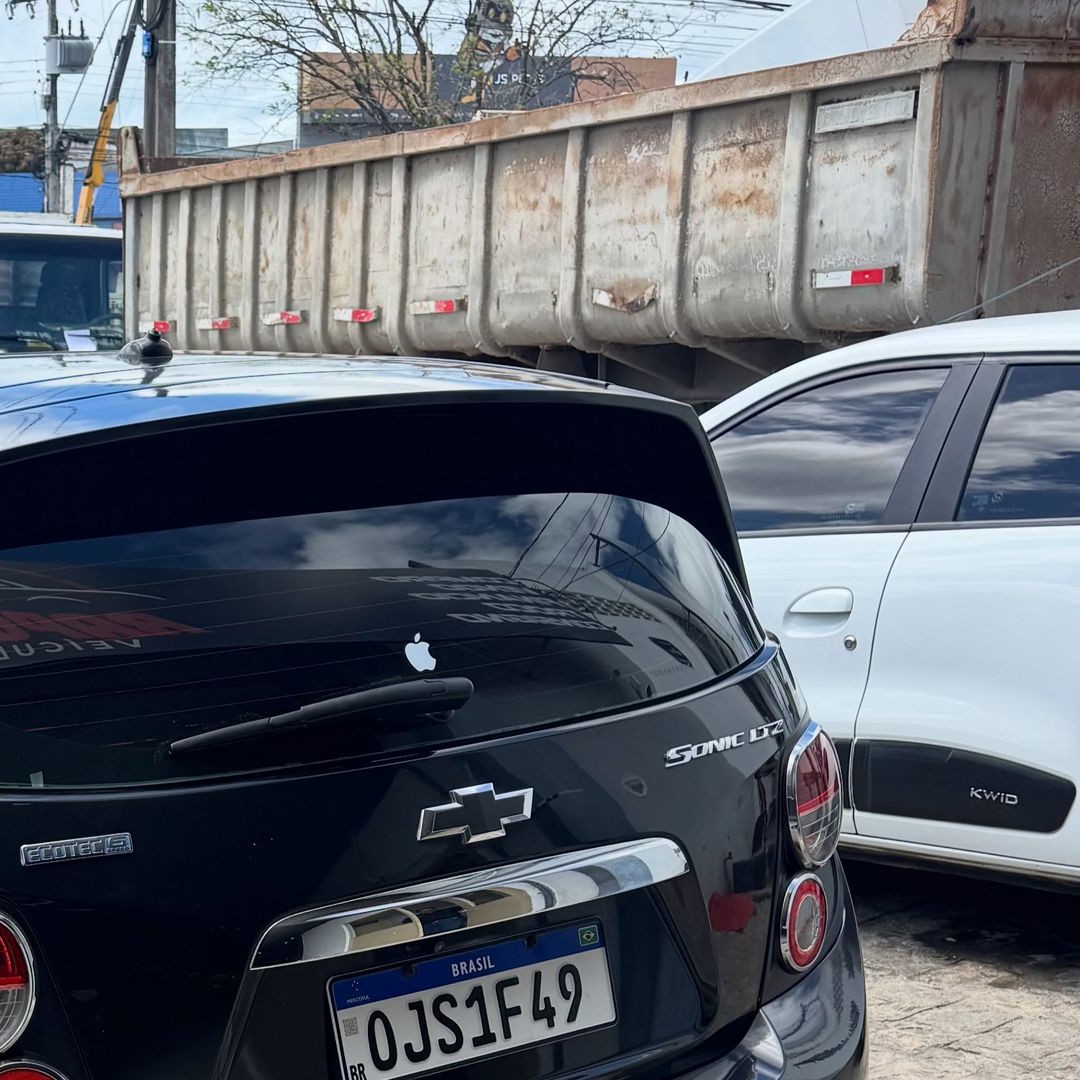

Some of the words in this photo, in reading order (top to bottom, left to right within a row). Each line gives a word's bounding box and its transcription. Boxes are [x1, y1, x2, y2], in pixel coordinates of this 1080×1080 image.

[665, 732, 745, 768] SONIC
[749, 719, 784, 743] LTZ
[25, 839, 104, 862] ECOTEC
[451, 955, 495, 977] BRASIL
[367, 964, 583, 1071] OJS1F49
